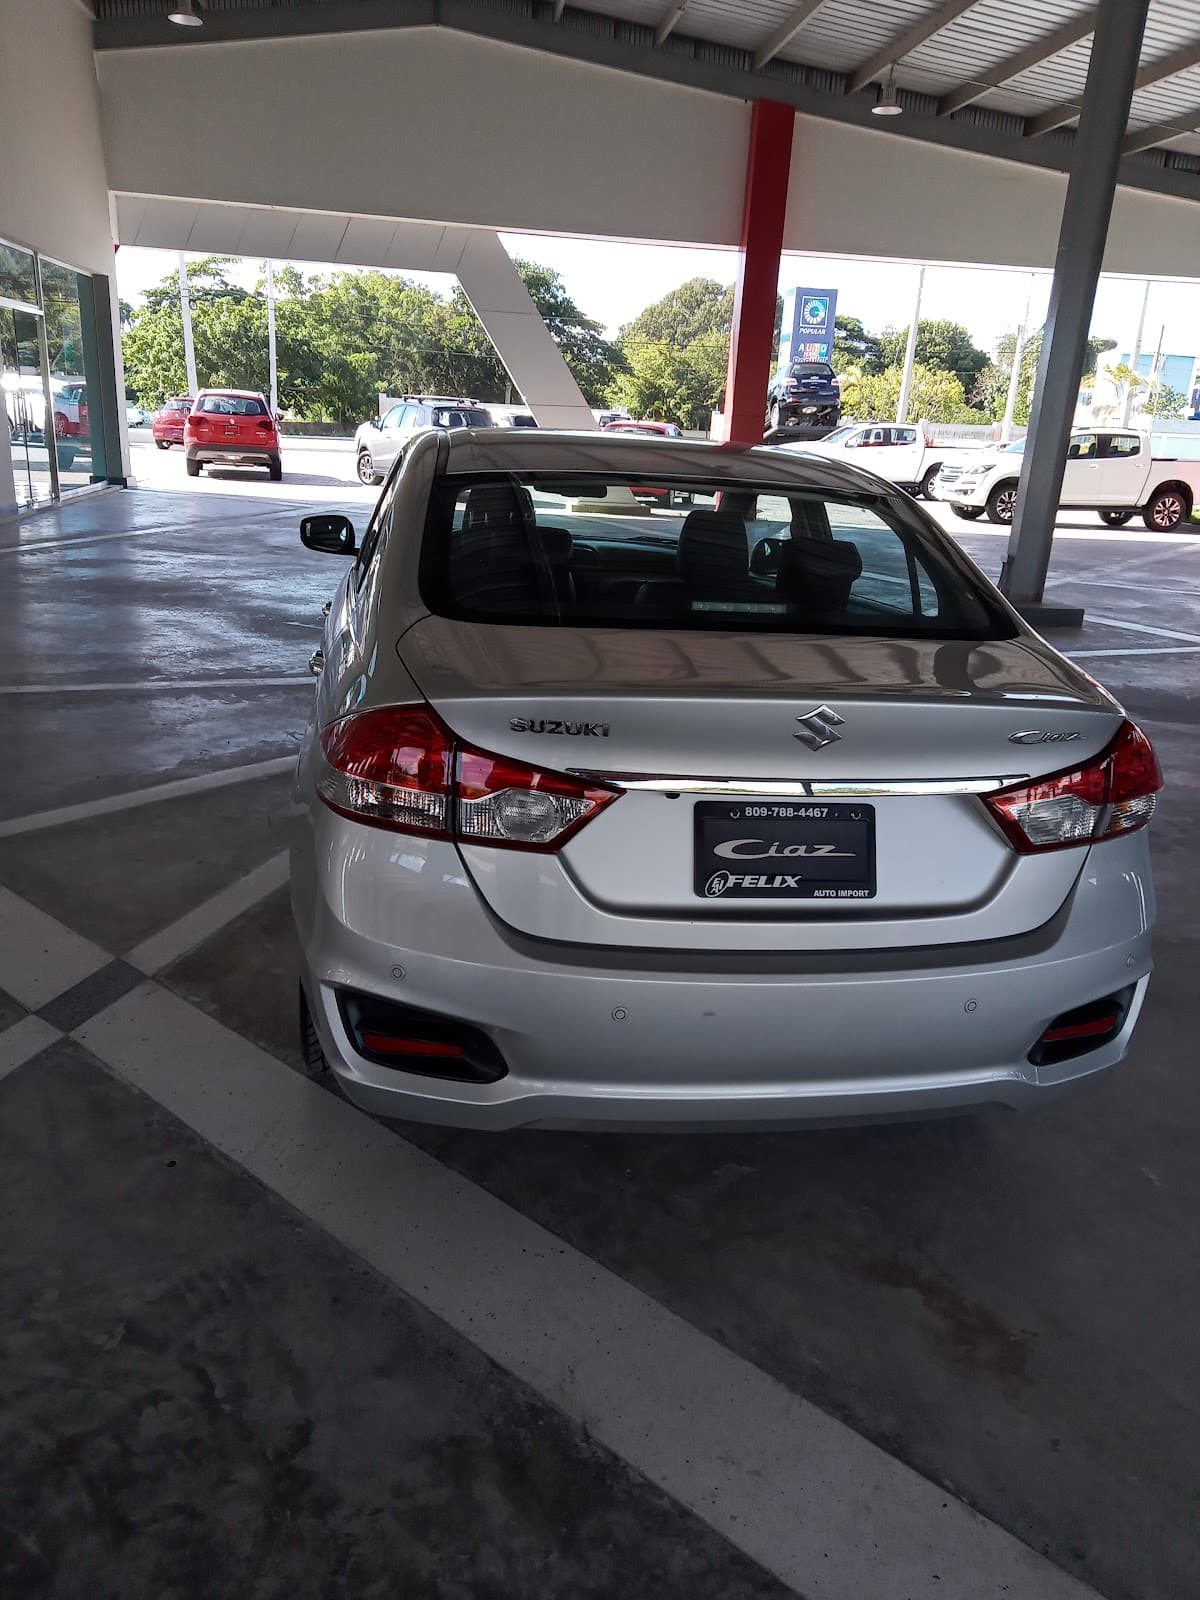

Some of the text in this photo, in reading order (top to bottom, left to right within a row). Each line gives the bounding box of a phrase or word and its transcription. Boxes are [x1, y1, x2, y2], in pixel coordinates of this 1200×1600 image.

[798, 343, 828, 352] AUTO
[509, 717, 610, 737] SUZUKI
[1007, 729, 1088, 745] Ciaz
[745, 807, 829, 818] 809-788-4467
[713, 839, 856, 859] Ciaz
[726, 875, 802, 887] FELIX
[813, 890, 870, 898] AUTO IMPORT
